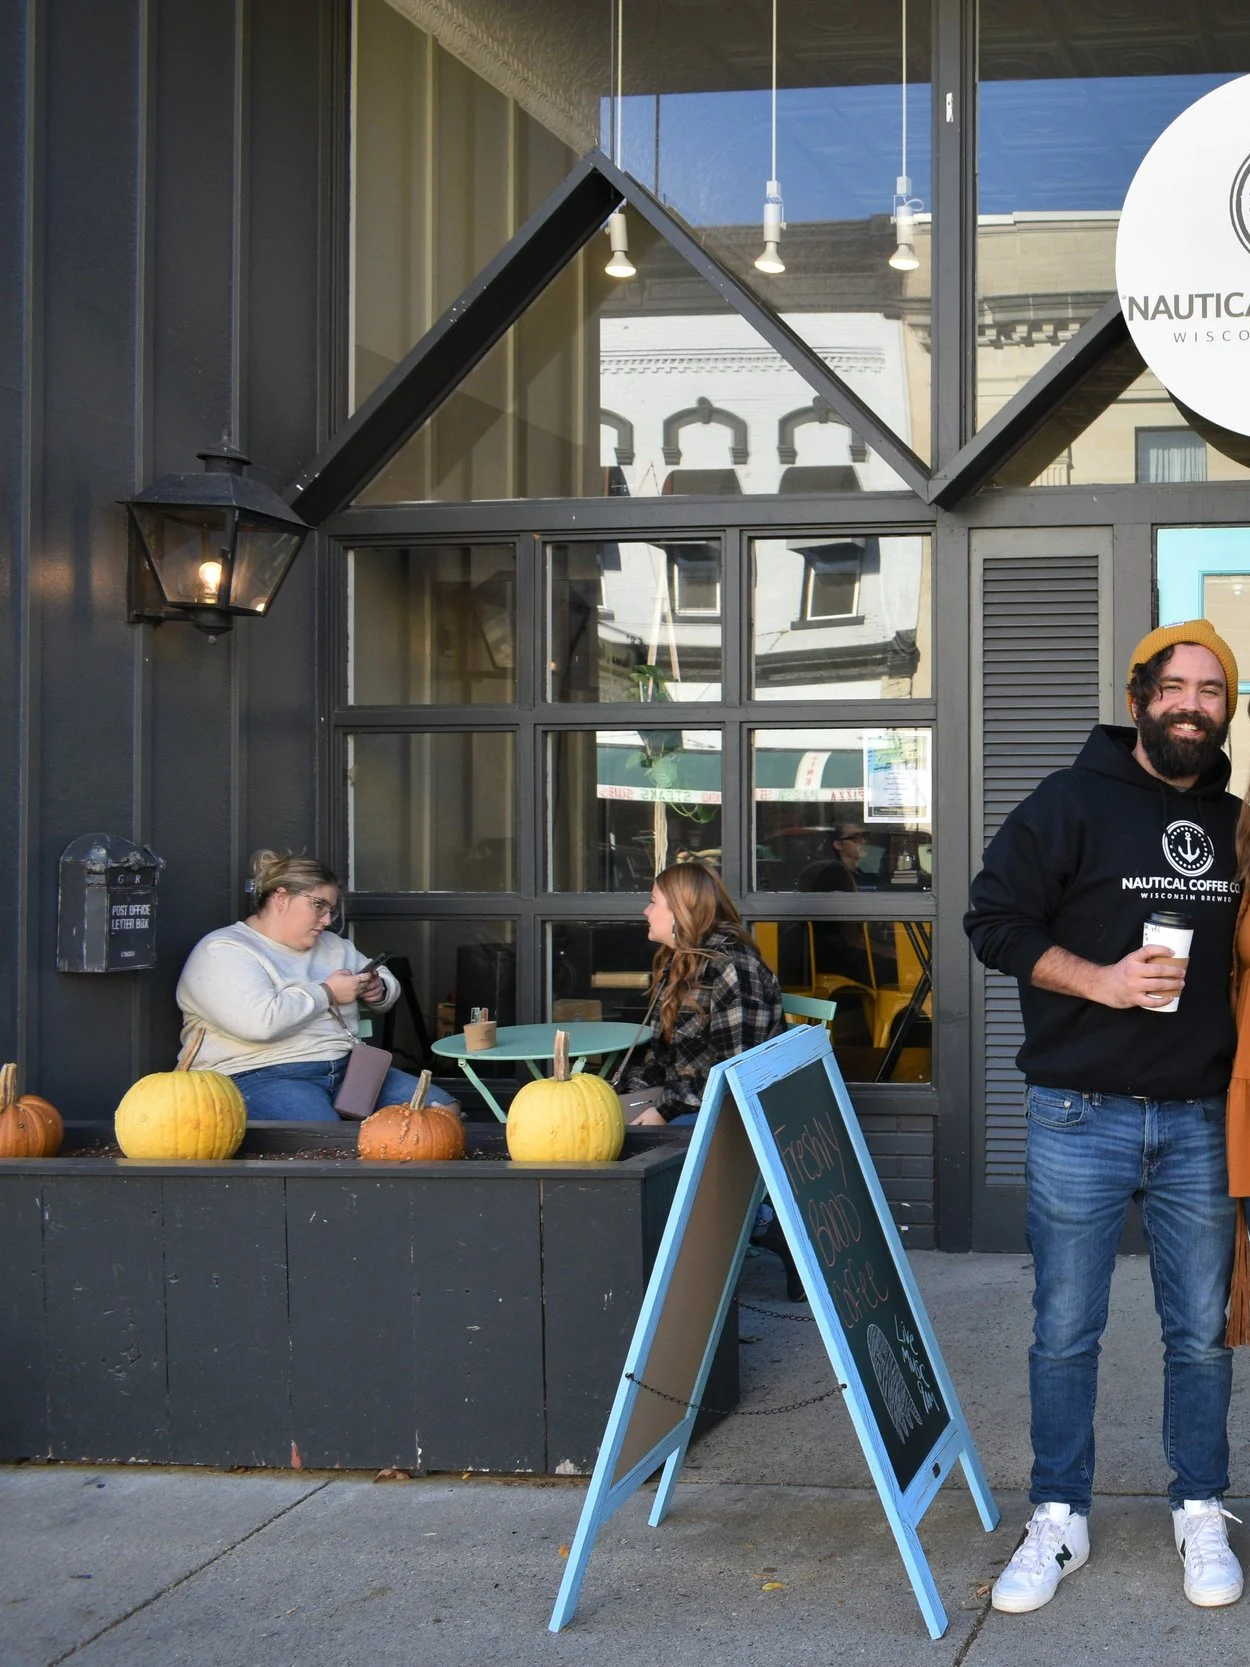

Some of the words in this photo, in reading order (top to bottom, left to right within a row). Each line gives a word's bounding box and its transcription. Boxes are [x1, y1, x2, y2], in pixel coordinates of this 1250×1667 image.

[134, 874, 141, 884] R
[1122, 877, 1187, 890] NAUTICAL
[1189, 879, 1229, 892] COFFEE
[1140, 892, 1196, 901] WISCONSIN
[1201, 894, 1232, 903] BREWED
[112, 904, 128, 916] POST
[128, 904, 151, 916] OFFICE
[111, 918, 135, 931] LETTER
[135, 917, 149, 929] BOX
[774, 1111, 848, 1196] Freshly
[831, 1258, 890, 1330] Coffee
[893, 1314, 919, 1356] Live
